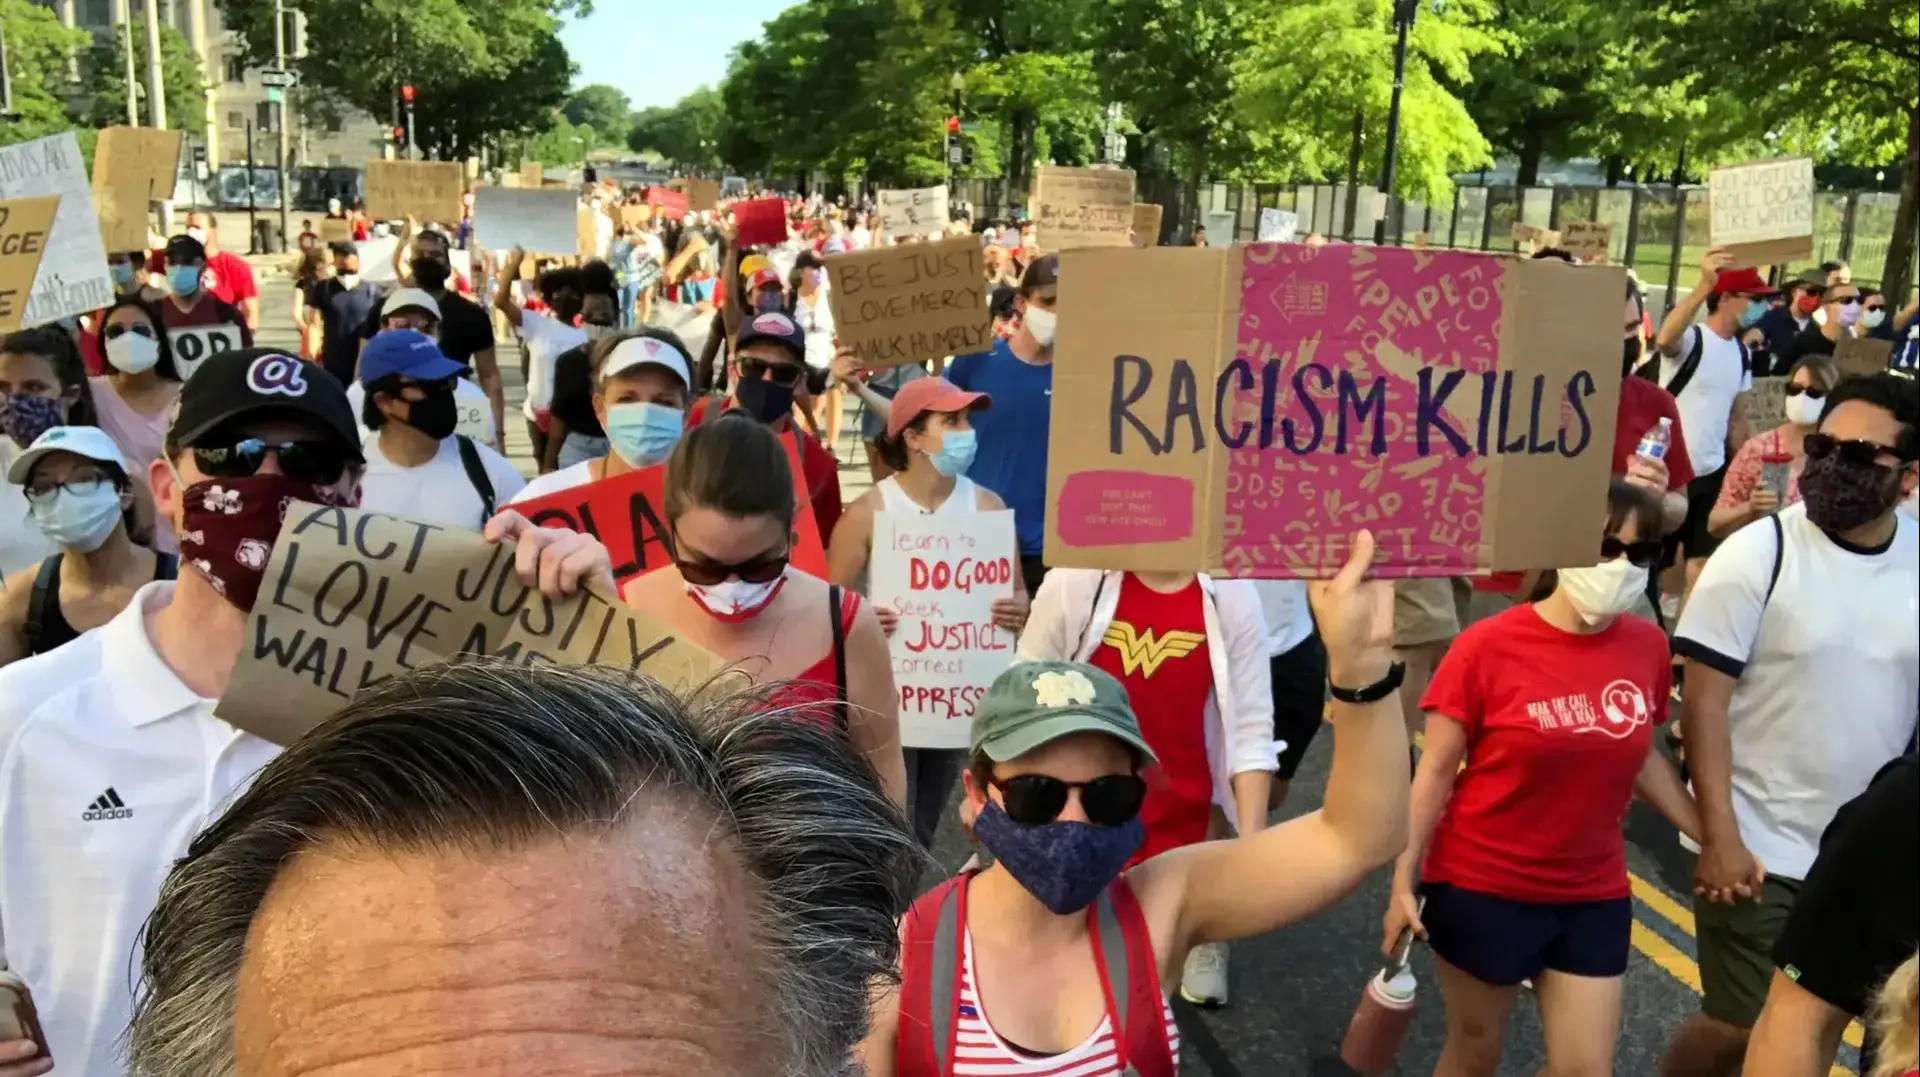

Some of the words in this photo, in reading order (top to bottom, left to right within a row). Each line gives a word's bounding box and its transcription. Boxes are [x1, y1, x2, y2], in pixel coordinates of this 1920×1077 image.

[1714, 191, 1756, 211] ROLL
[1763, 182, 1812, 207] DOWN
[1714, 211, 1751, 233] LIKE
[0, 231, 43, 256] CE
[839, 262, 886, 295] BE
[901, 250, 979, 285] JUST
[840, 295, 906, 326] LOVE
[911, 283, 985, 314] MERCY
[909, 322, 988, 352] HUMBLY
[456, 406, 482, 425] ce
[1108, 353, 1389, 458] RACISM
[1415, 366, 1598, 459] KILLS
[291, 505, 443, 574] ACT
[891, 519, 949, 551] learn
[958, 532, 975, 547] to
[910, 557, 951, 591] DO
[954, 556, 1012, 594] GOOD
[272, 540, 452, 673] LOVE
[905, 620, 1007, 653] JUSTICE
[900, 685, 985, 719] PPRES
[82, 808, 133, 822] adidas
